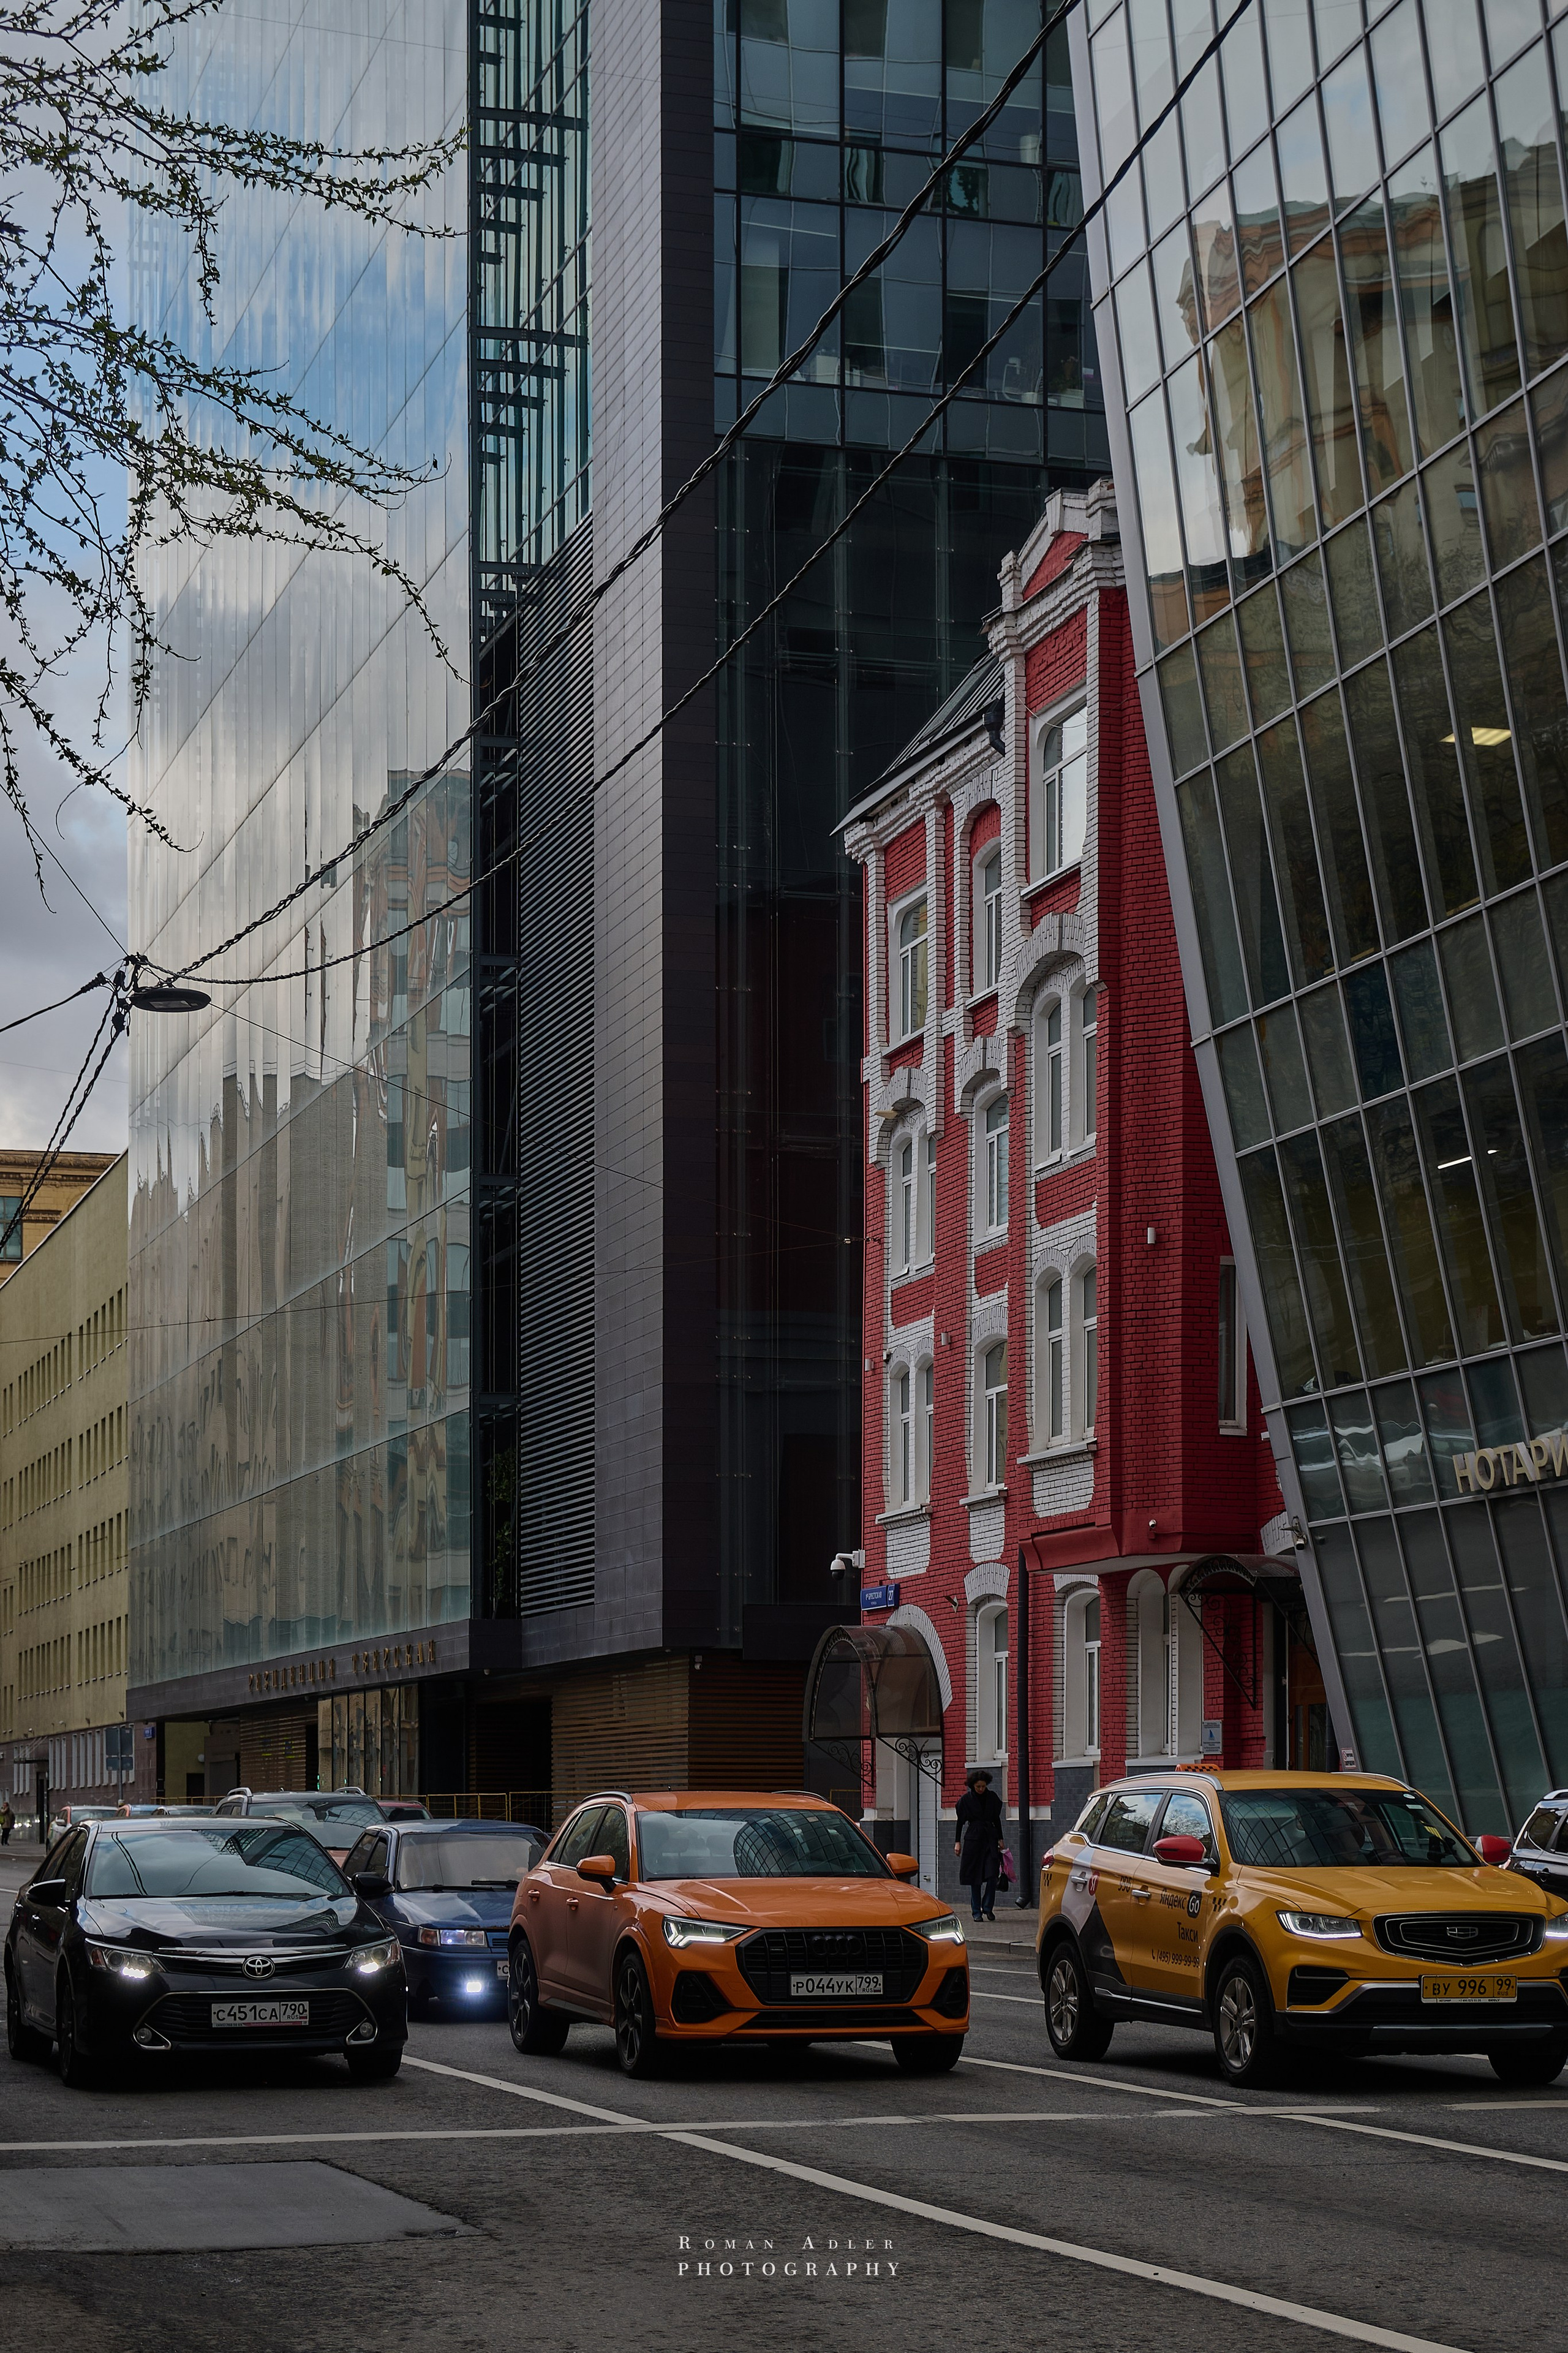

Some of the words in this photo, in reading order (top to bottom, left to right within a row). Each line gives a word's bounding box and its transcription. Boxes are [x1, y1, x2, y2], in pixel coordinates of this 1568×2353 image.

[1452, 1434, 1568, 1494] НОТАРИ
[888, 1590, 894, 1601] 27
[248, 1658, 335, 1691] РЕЗИДЕНЦИЯ
[352, 1639, 435, 1674] ТВЕРСКАЯ
[1118, 1876, 1133, 1893] 996
[1159, 1887, 1187, 1910] Яндекс
[1189, 1895, 1199, 1914] Go
[1177, 1921, 1198, 1943] Такси
[1157, 1949, 1170, 1965] (495)
[1171, 1952, 1200, 1968] 999-99-99
[858, 1976, 879, 1989] 799
[1458, 1979, 1487, 1995] 996
[1496, 1978, 1512, 1991] 99
[281, 2003, 305, 2015] 790
